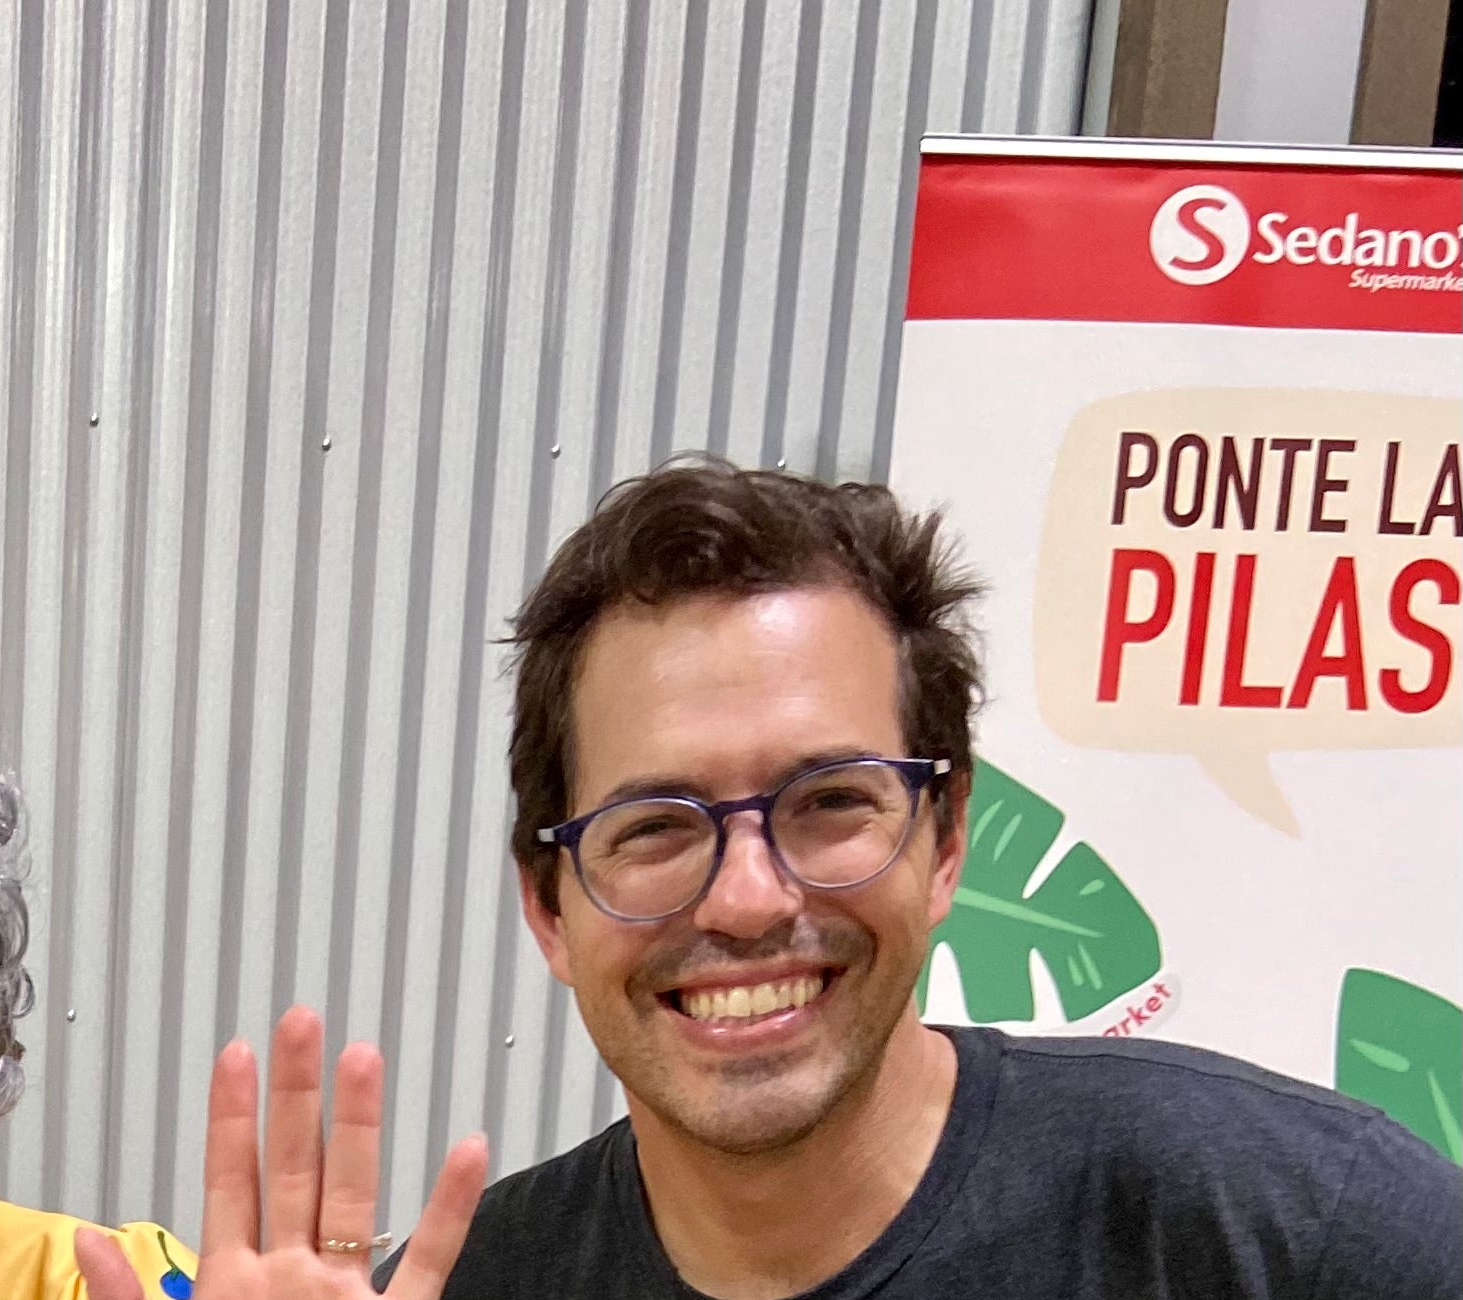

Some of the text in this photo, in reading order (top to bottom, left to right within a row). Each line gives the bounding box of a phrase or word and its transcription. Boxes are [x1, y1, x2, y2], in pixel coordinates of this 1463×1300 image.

[1251, 211, 1463, 269] Sedano'
[1110, 431, 1463, 537] PONTE LA
[1096, 547, 1461, 714] PILAS
[1102, 982, 1173, 1038] arket
